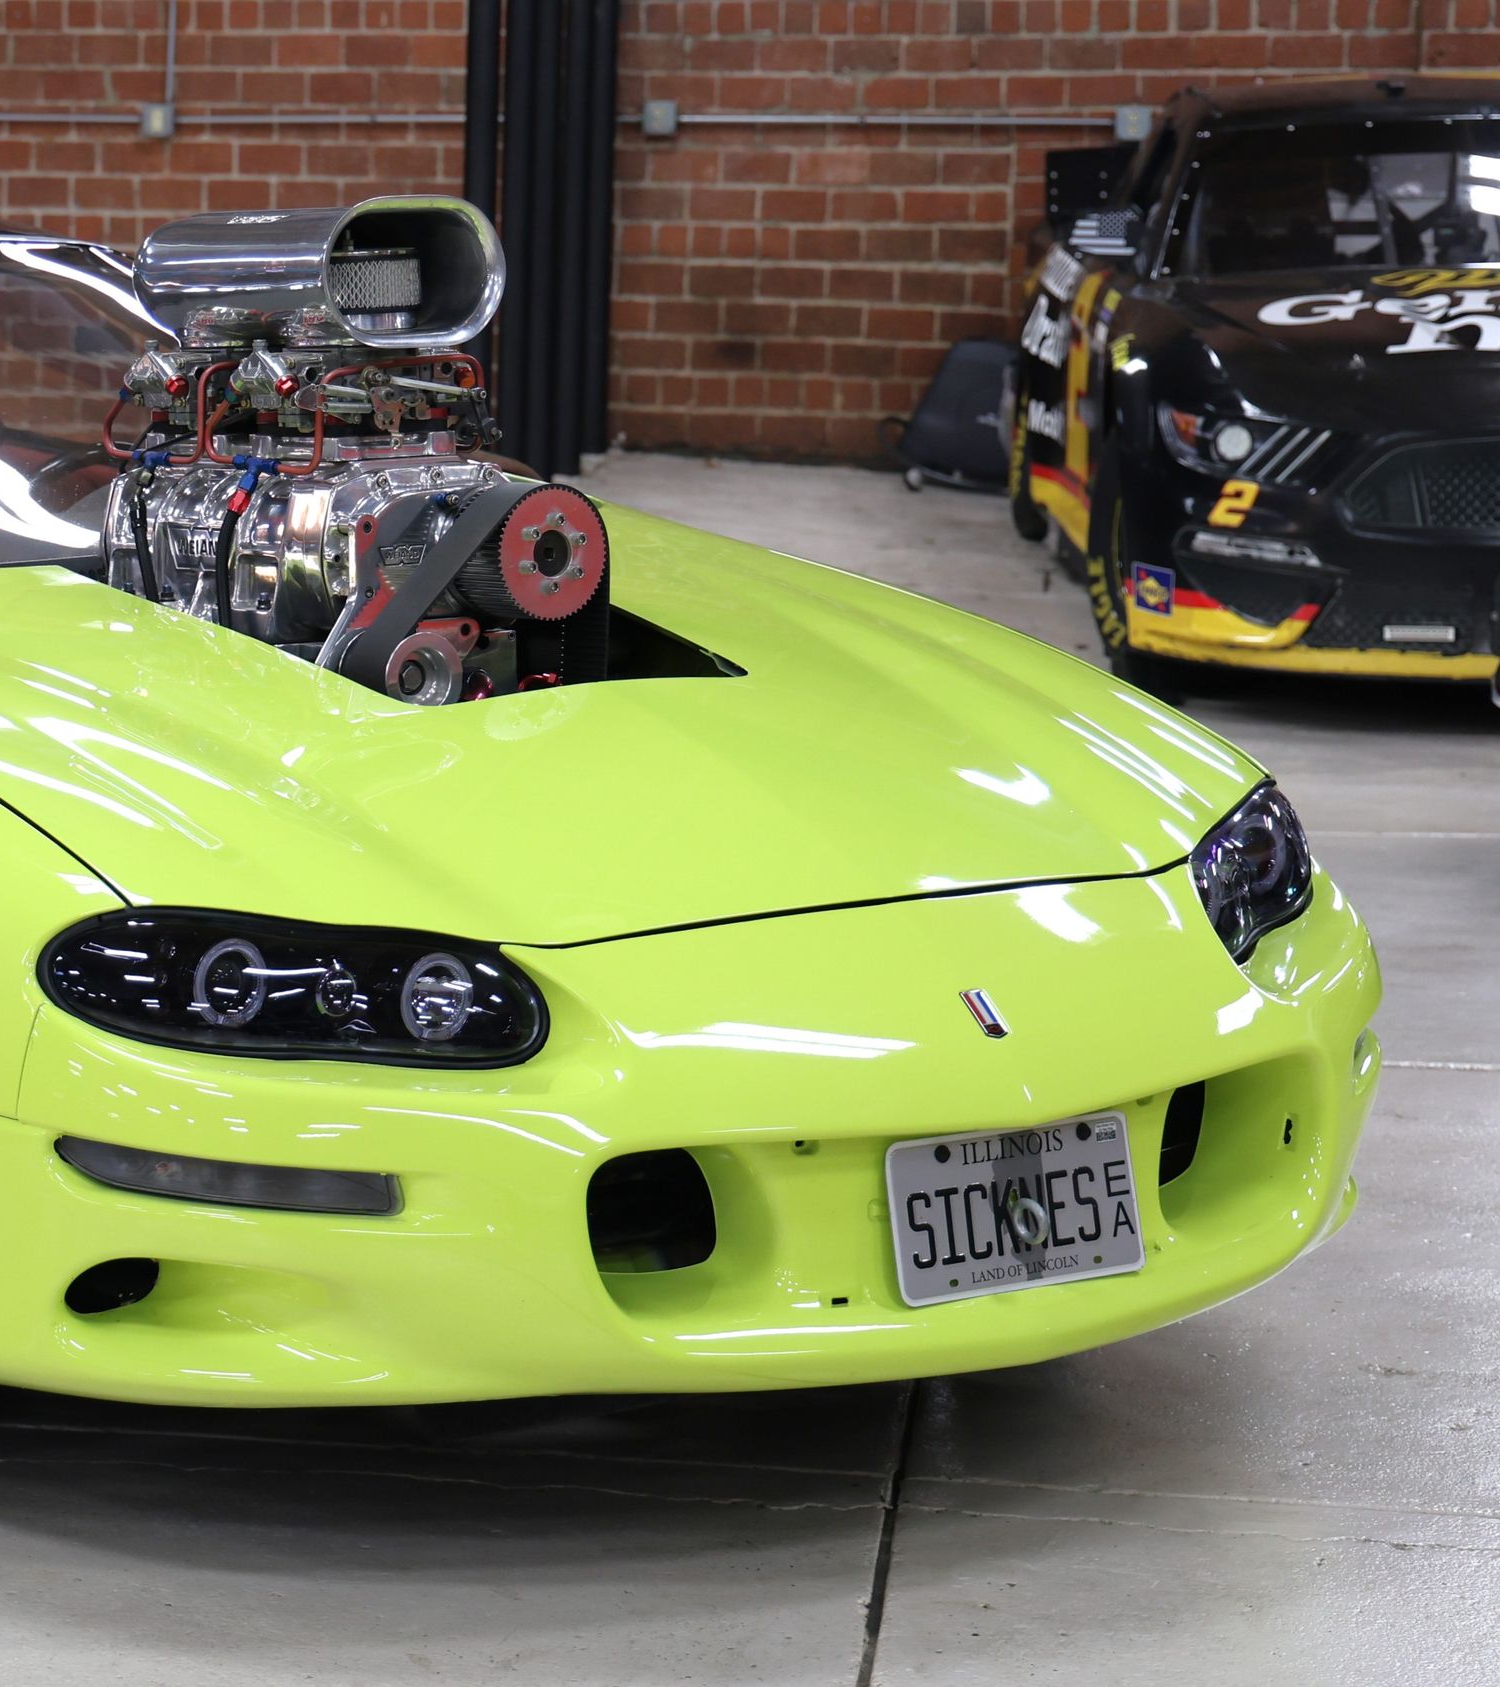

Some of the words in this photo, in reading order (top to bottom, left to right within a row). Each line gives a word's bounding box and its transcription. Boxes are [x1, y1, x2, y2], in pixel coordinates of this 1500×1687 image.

[1206, 479, 1261, 528] 2
[175, 536, 217, 557] WEIAN
[960, 1128, 1064, 1166] ILLINOIS
[906, 1165, 1101, 1270] SICKNES
[971, 1266, 1006, 1284] LAND
[1008, 1264, 1024, 1278] OF
[1026, 1254, 1079, 1275] LINCOLN
